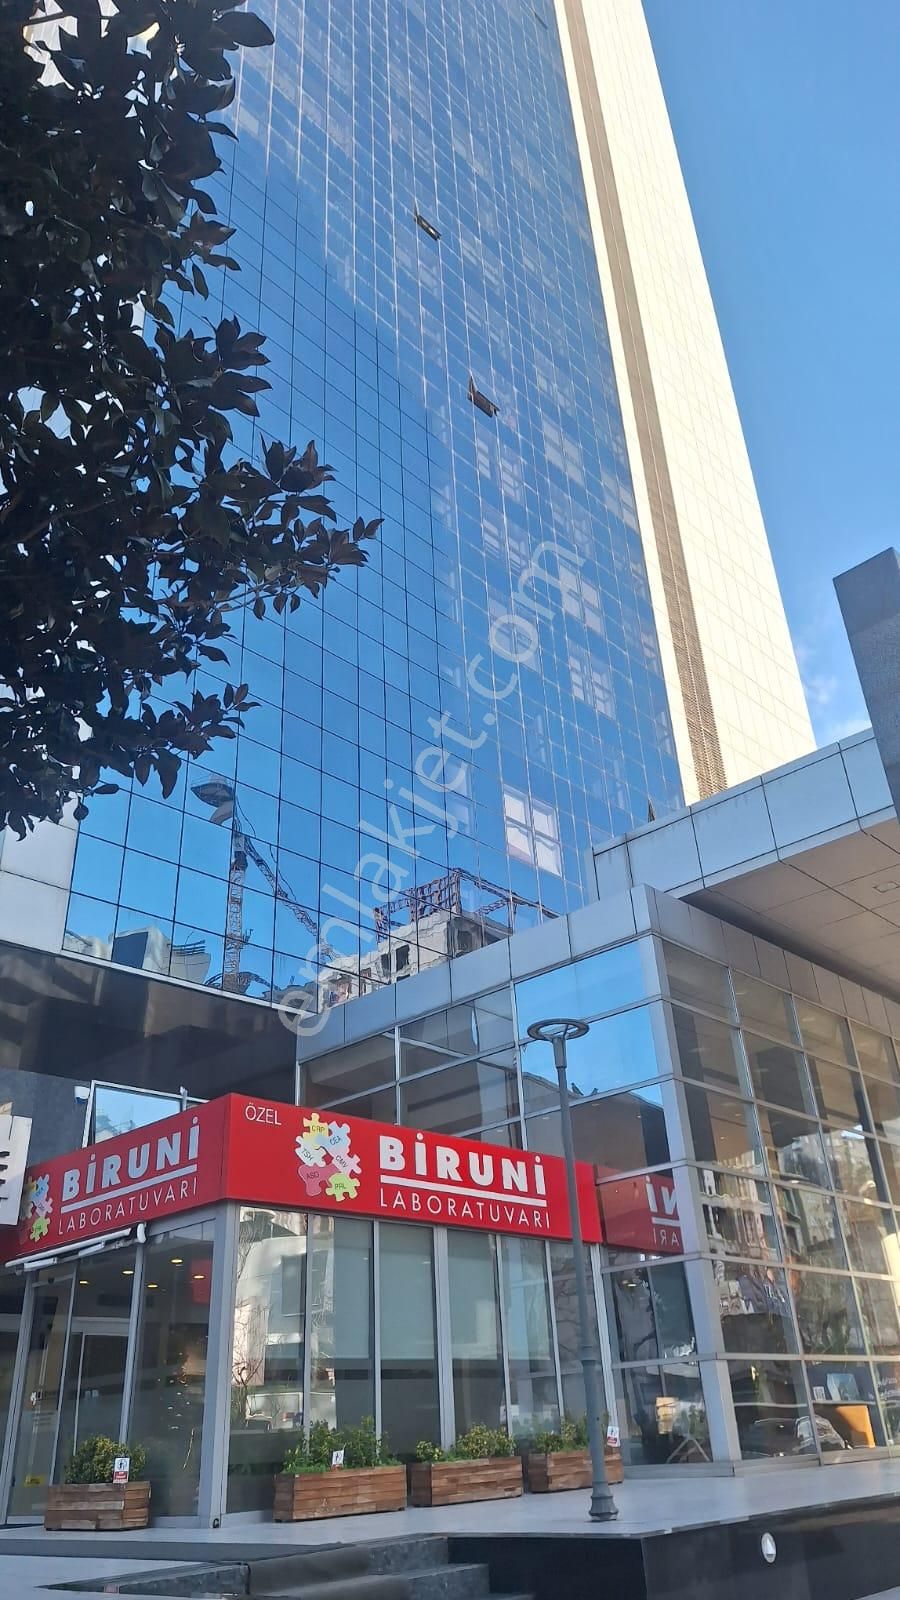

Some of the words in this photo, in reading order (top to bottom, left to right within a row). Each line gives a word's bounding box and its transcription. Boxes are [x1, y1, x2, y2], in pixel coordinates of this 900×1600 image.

[245, 1103, 282, 1125] ÖZEL
[58, 1177, 198, 1235] LABORATUVARI
[380, 1188, 551, 1229] LABORATUVARI
